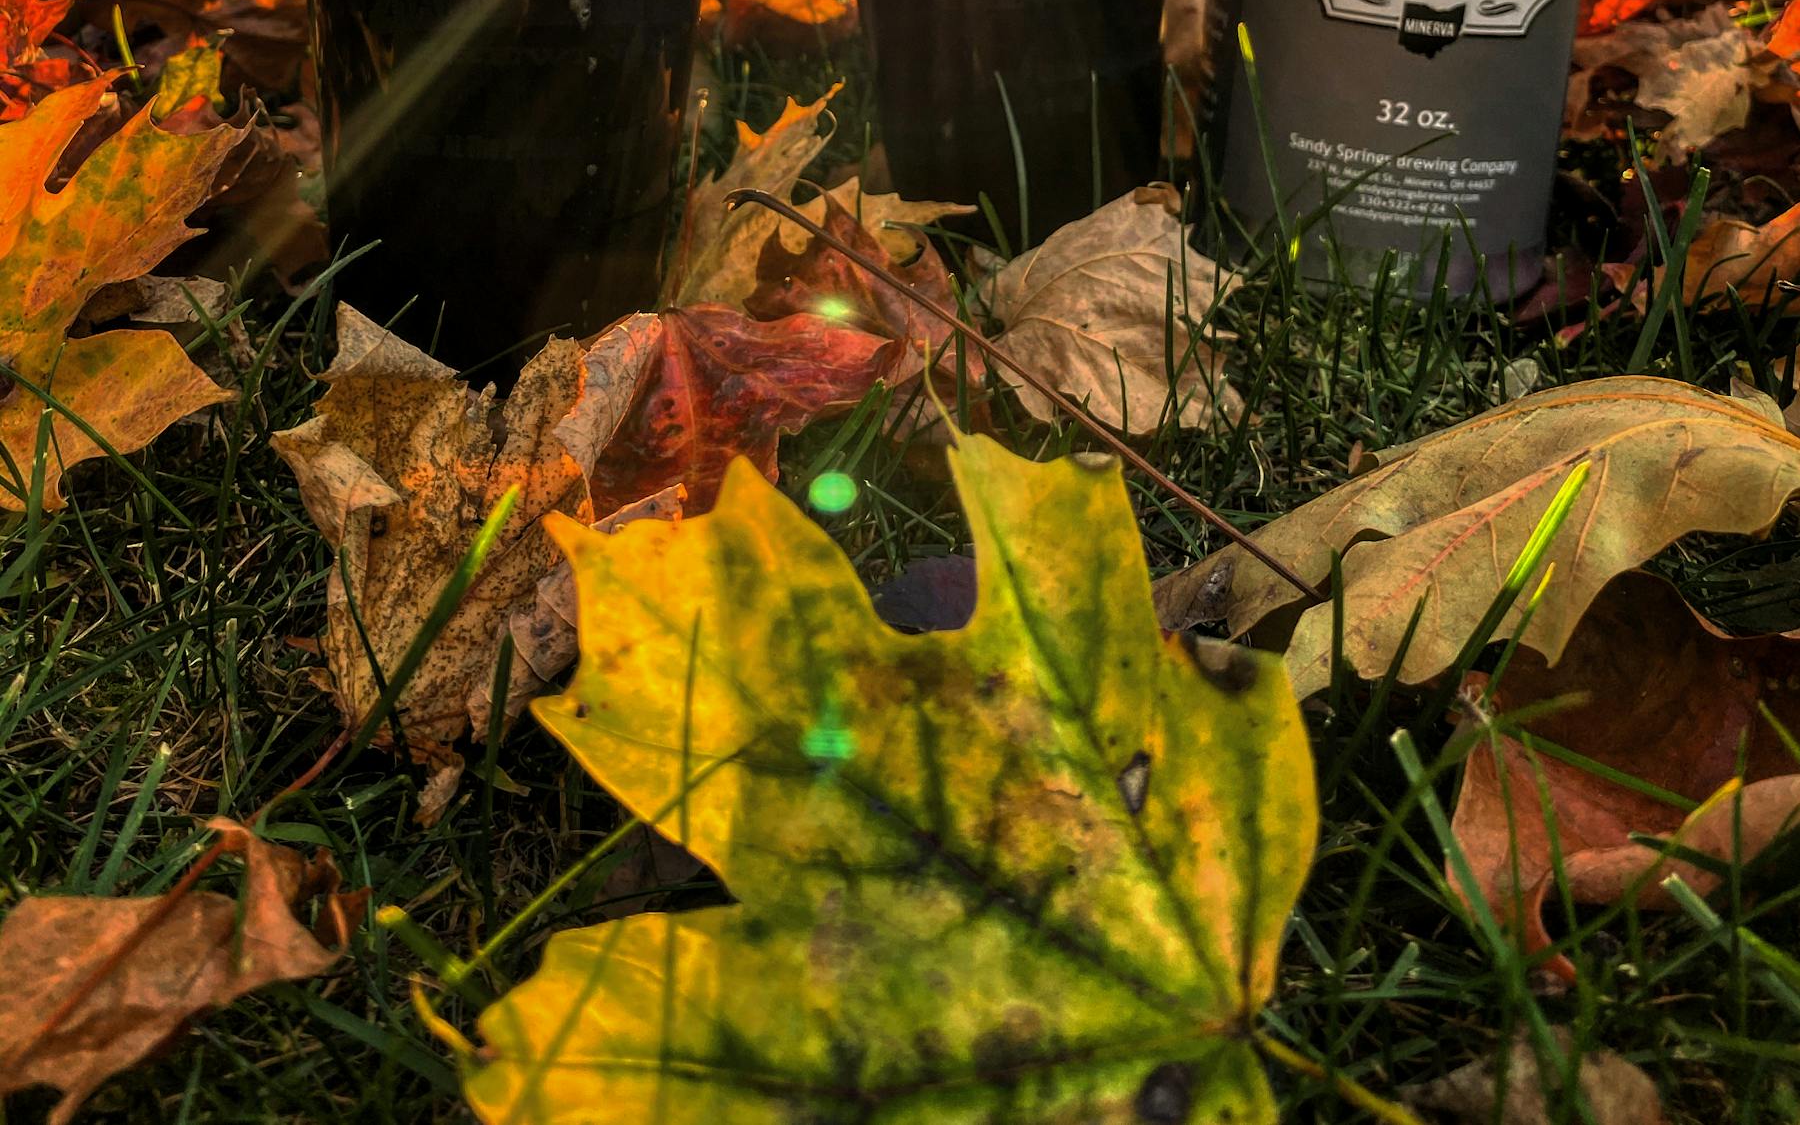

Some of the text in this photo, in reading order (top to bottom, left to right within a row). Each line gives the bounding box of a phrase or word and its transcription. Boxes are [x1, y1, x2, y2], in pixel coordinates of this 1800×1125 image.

[1403, 17, 1455, 38] MINERVA
[1375, 98, 1455, 129] 32 oz.
[1289, 132, 1332, 158] Sandy
[1336, 143, 1392, 167] Springs
[1460, 157, 1518, 177] Company
[1449, 178, 1466, 191] OH
